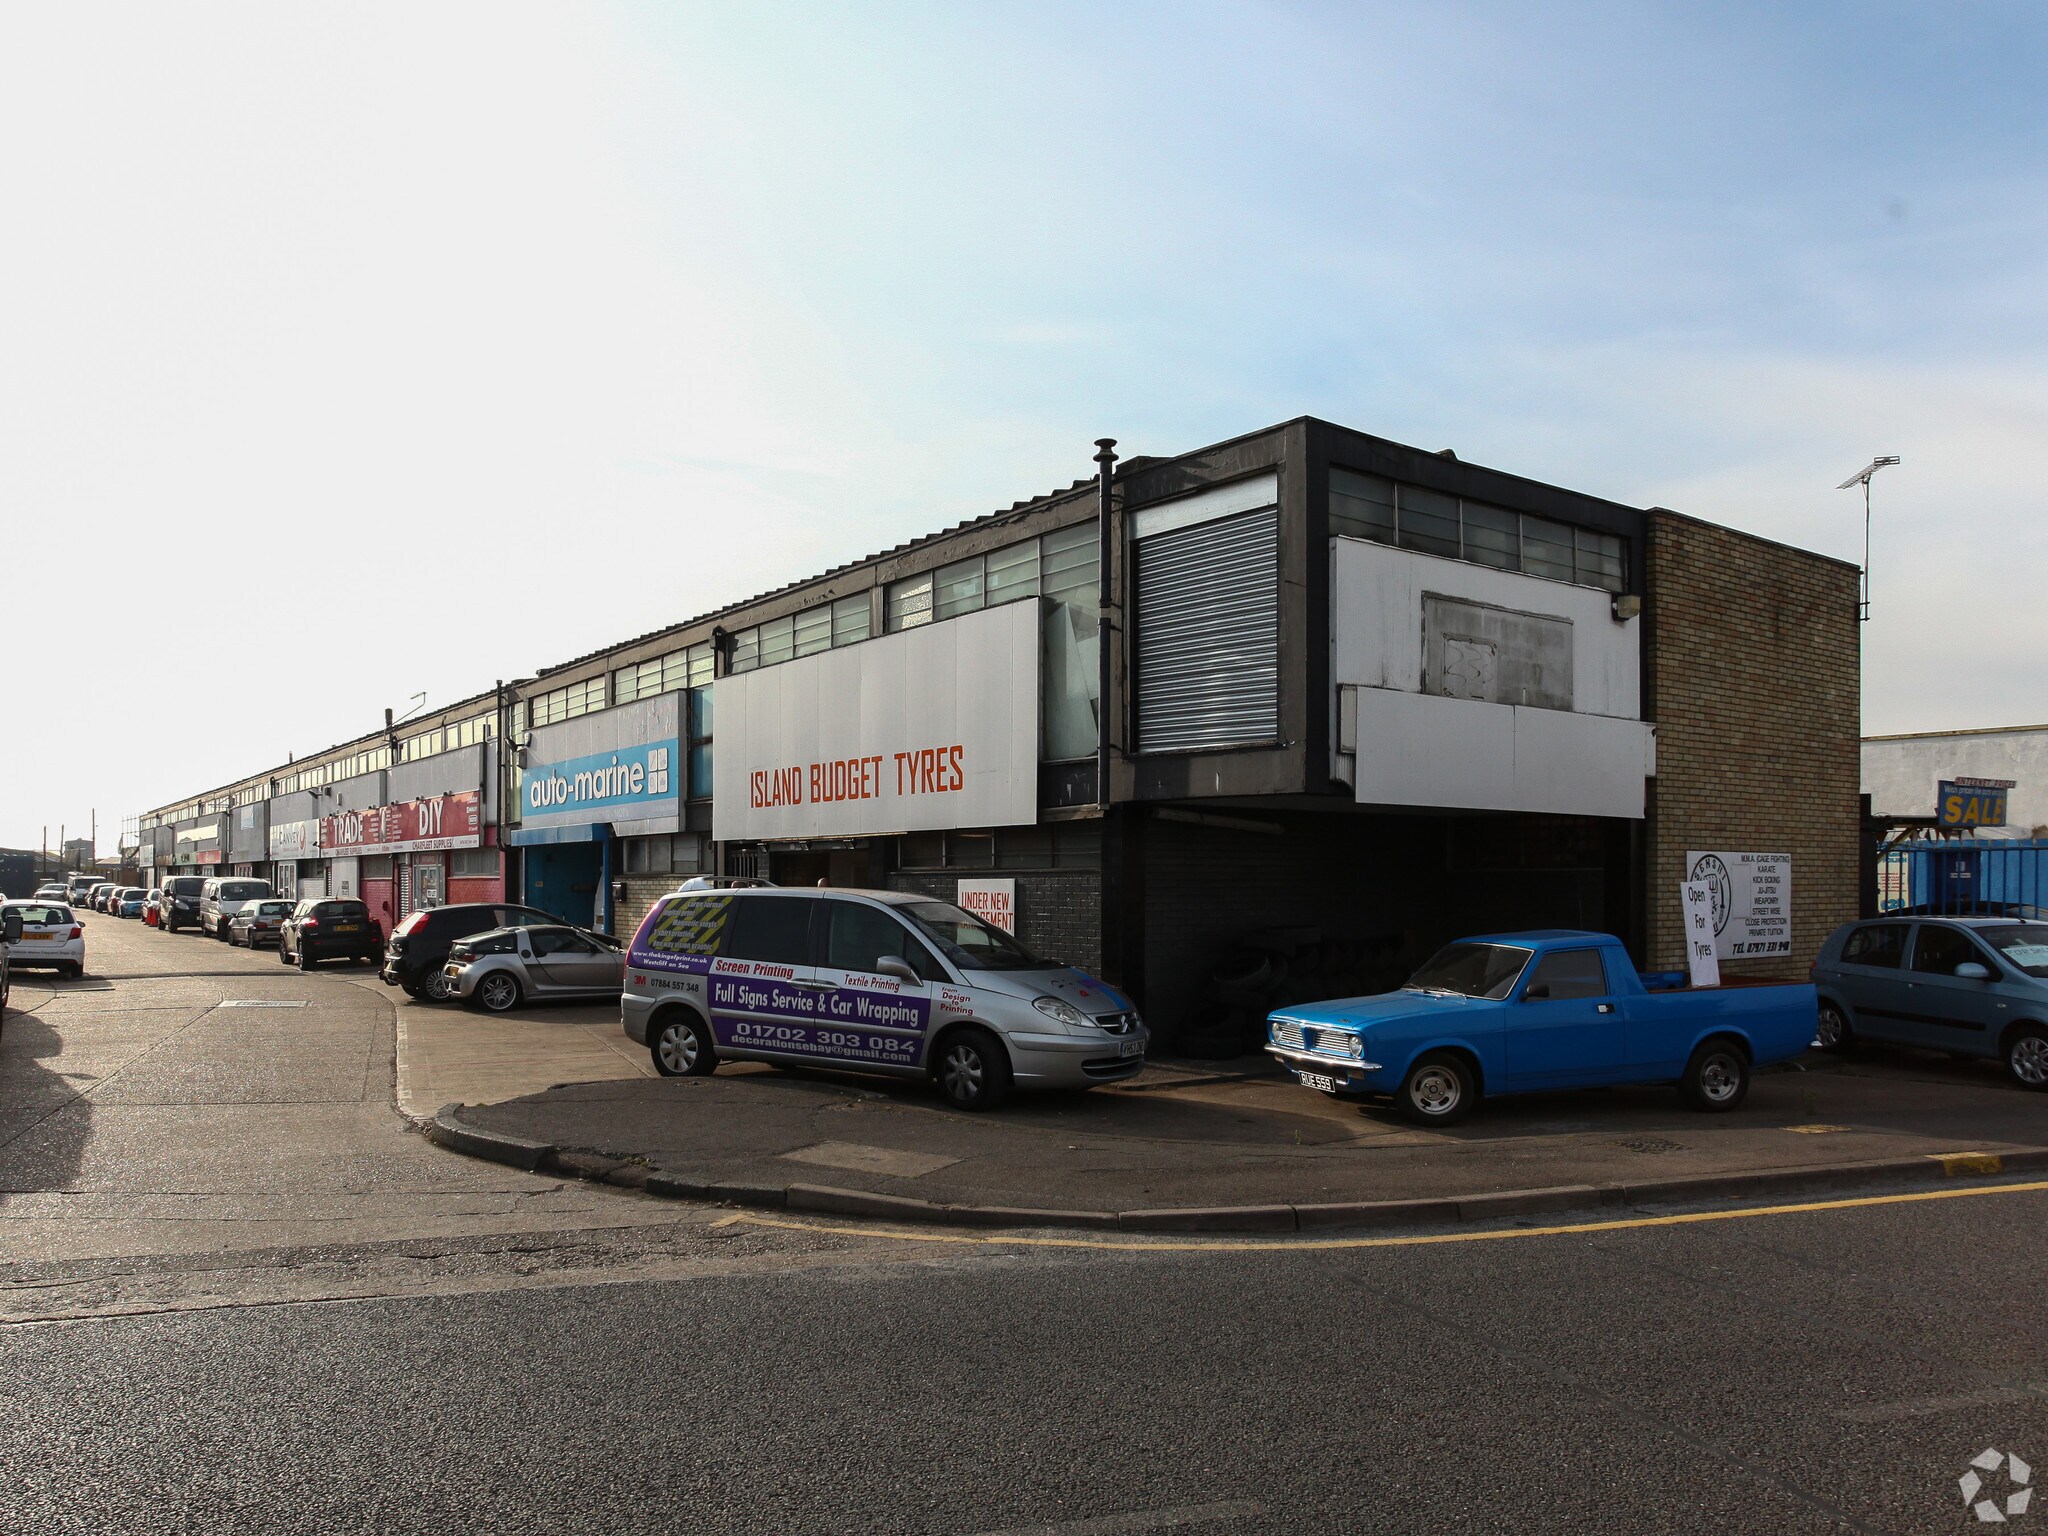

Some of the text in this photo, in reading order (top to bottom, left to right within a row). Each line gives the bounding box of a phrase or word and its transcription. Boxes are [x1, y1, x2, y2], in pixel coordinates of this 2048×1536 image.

[530, 755, 645, 809] auto-marine
[750, 745, 964, 809] ISLAND BUDGET TYRES
[419, 800, 444, 836] DIY
[1944, 796, 2004, 825] SALE
[333, 814, 364, 845] TRADE
[433, 839, 452, 849] SUPPLIES
[1694, 858, 1726, 881] SENSHI
[1752, 876, 1781, 884] KICK BOXING
[961, 892, 1010, 911] UNDER NEW
[1688, 886, 1706, 905] Open
[1754, 897, 1779, 905] WEAPONRY
[1770, 907, 1781, 915] WISE
[1695, 914, 1705, 929] For
[1745, 918, 1787, 927] CLOSE PROTECTION
[1749, 928, 1784, 937] PRIVATE TUITION
[633, 951, 708, 964] www.thekingofprint.co.uk
[1694, 941, 1712, 960] Tyres
[2030, 946, 2048, 954] SAL
[643, 958, 668, 967] Westcliff
[715, 959, 794, 980] Screen Printing
[634, 975, 647, 985] 3M
[651, 978, 699, 992] 07884 557 348
[844, 973, 901, 993] Textile Printing
[715, 982, 919, 1028] Full Signs Service & Car Wrapping
[942, 992, 971, 1003] Design
[940, 1003, 974, 1016] Printing
[736, 1023, 916, 1053] 01702 303 084
[731, 1034, 911, 1062] decorationsebay@gmail.com
[1315, 1076, 1331, 1090] 559
